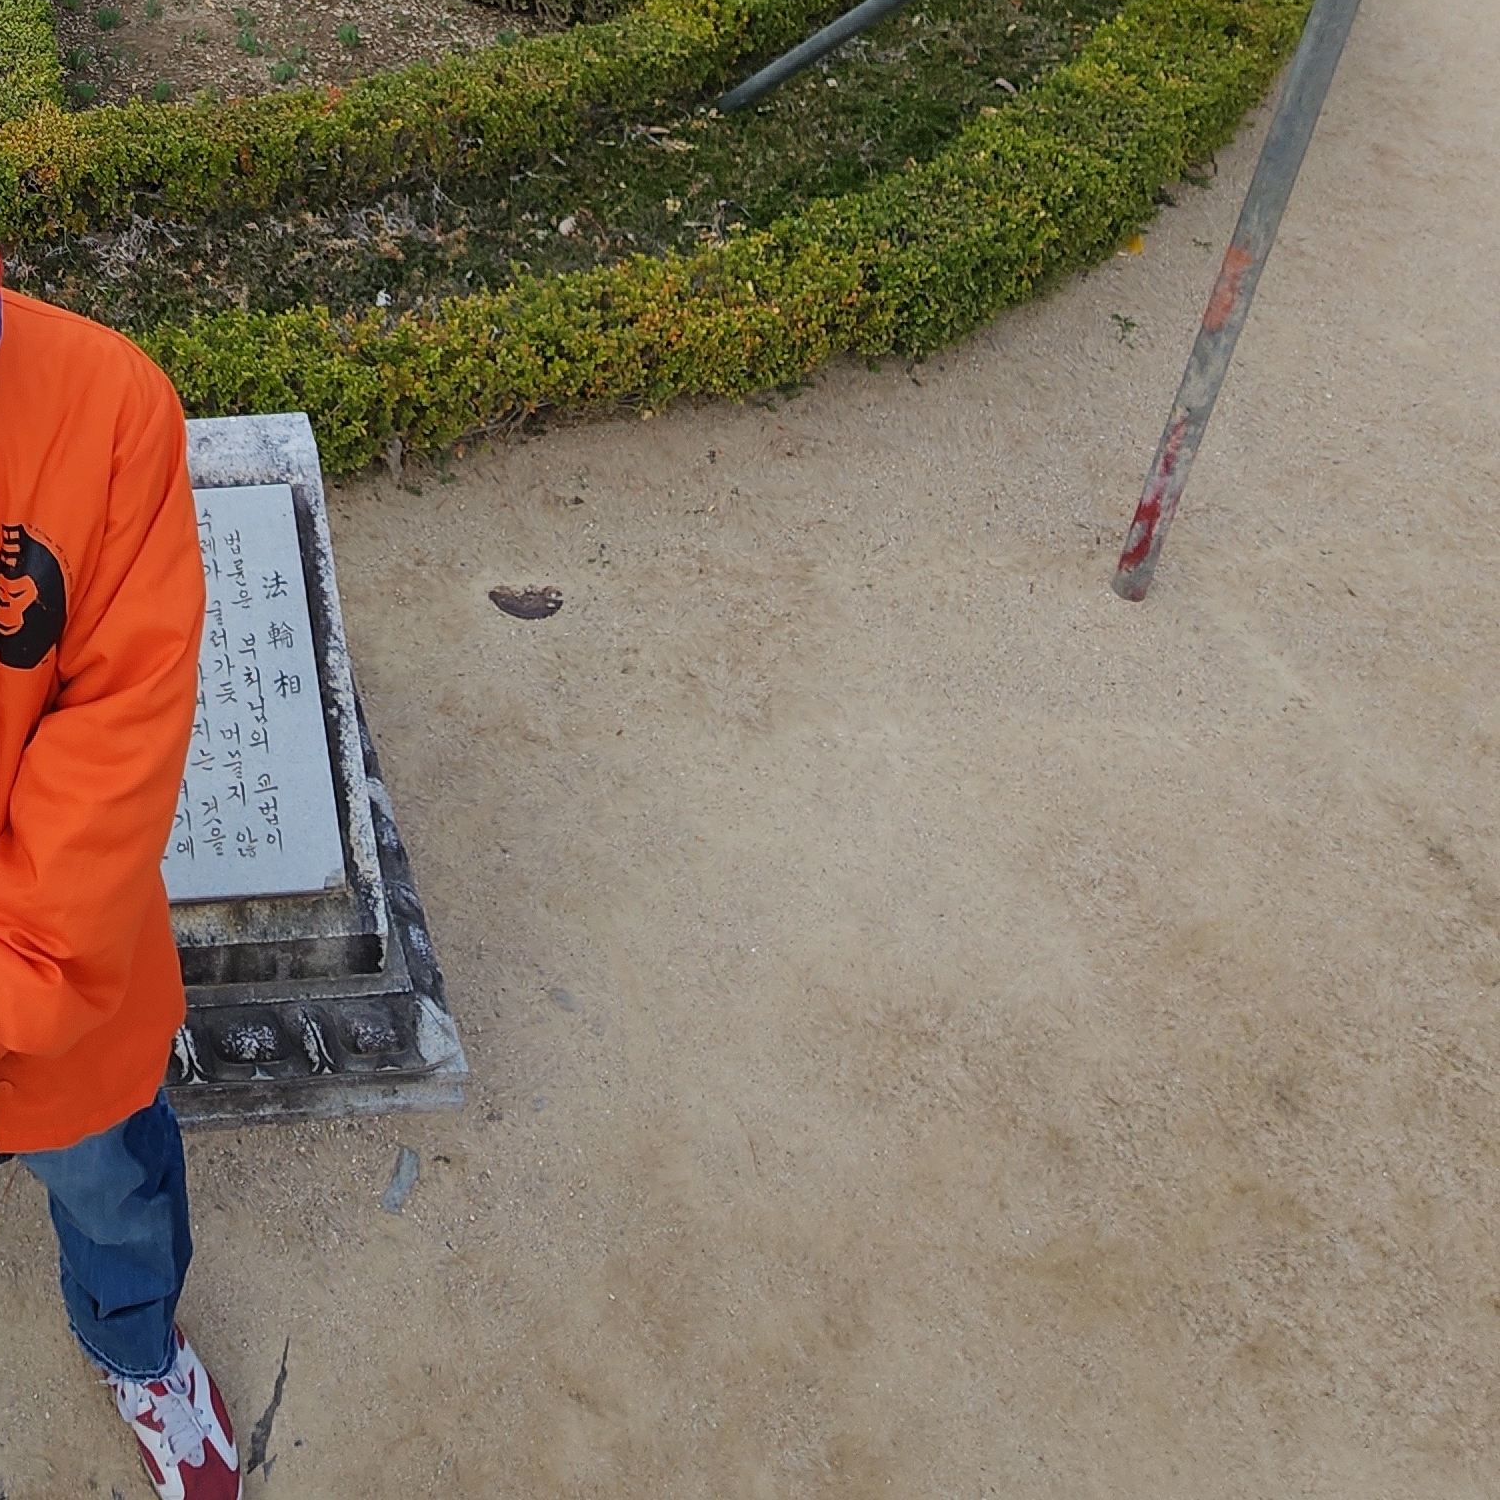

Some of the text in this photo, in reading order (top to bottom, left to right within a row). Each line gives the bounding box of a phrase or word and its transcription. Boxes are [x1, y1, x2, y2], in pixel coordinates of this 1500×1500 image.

[197, 508, 258, 858] 수레가 굴러가듯 머물지 않
[223, 528, 283, 854] 법륜은 부처님의 교법이
[262, 570, 302, 699] 法輪相
[202, 795, 226, 856] 것을
